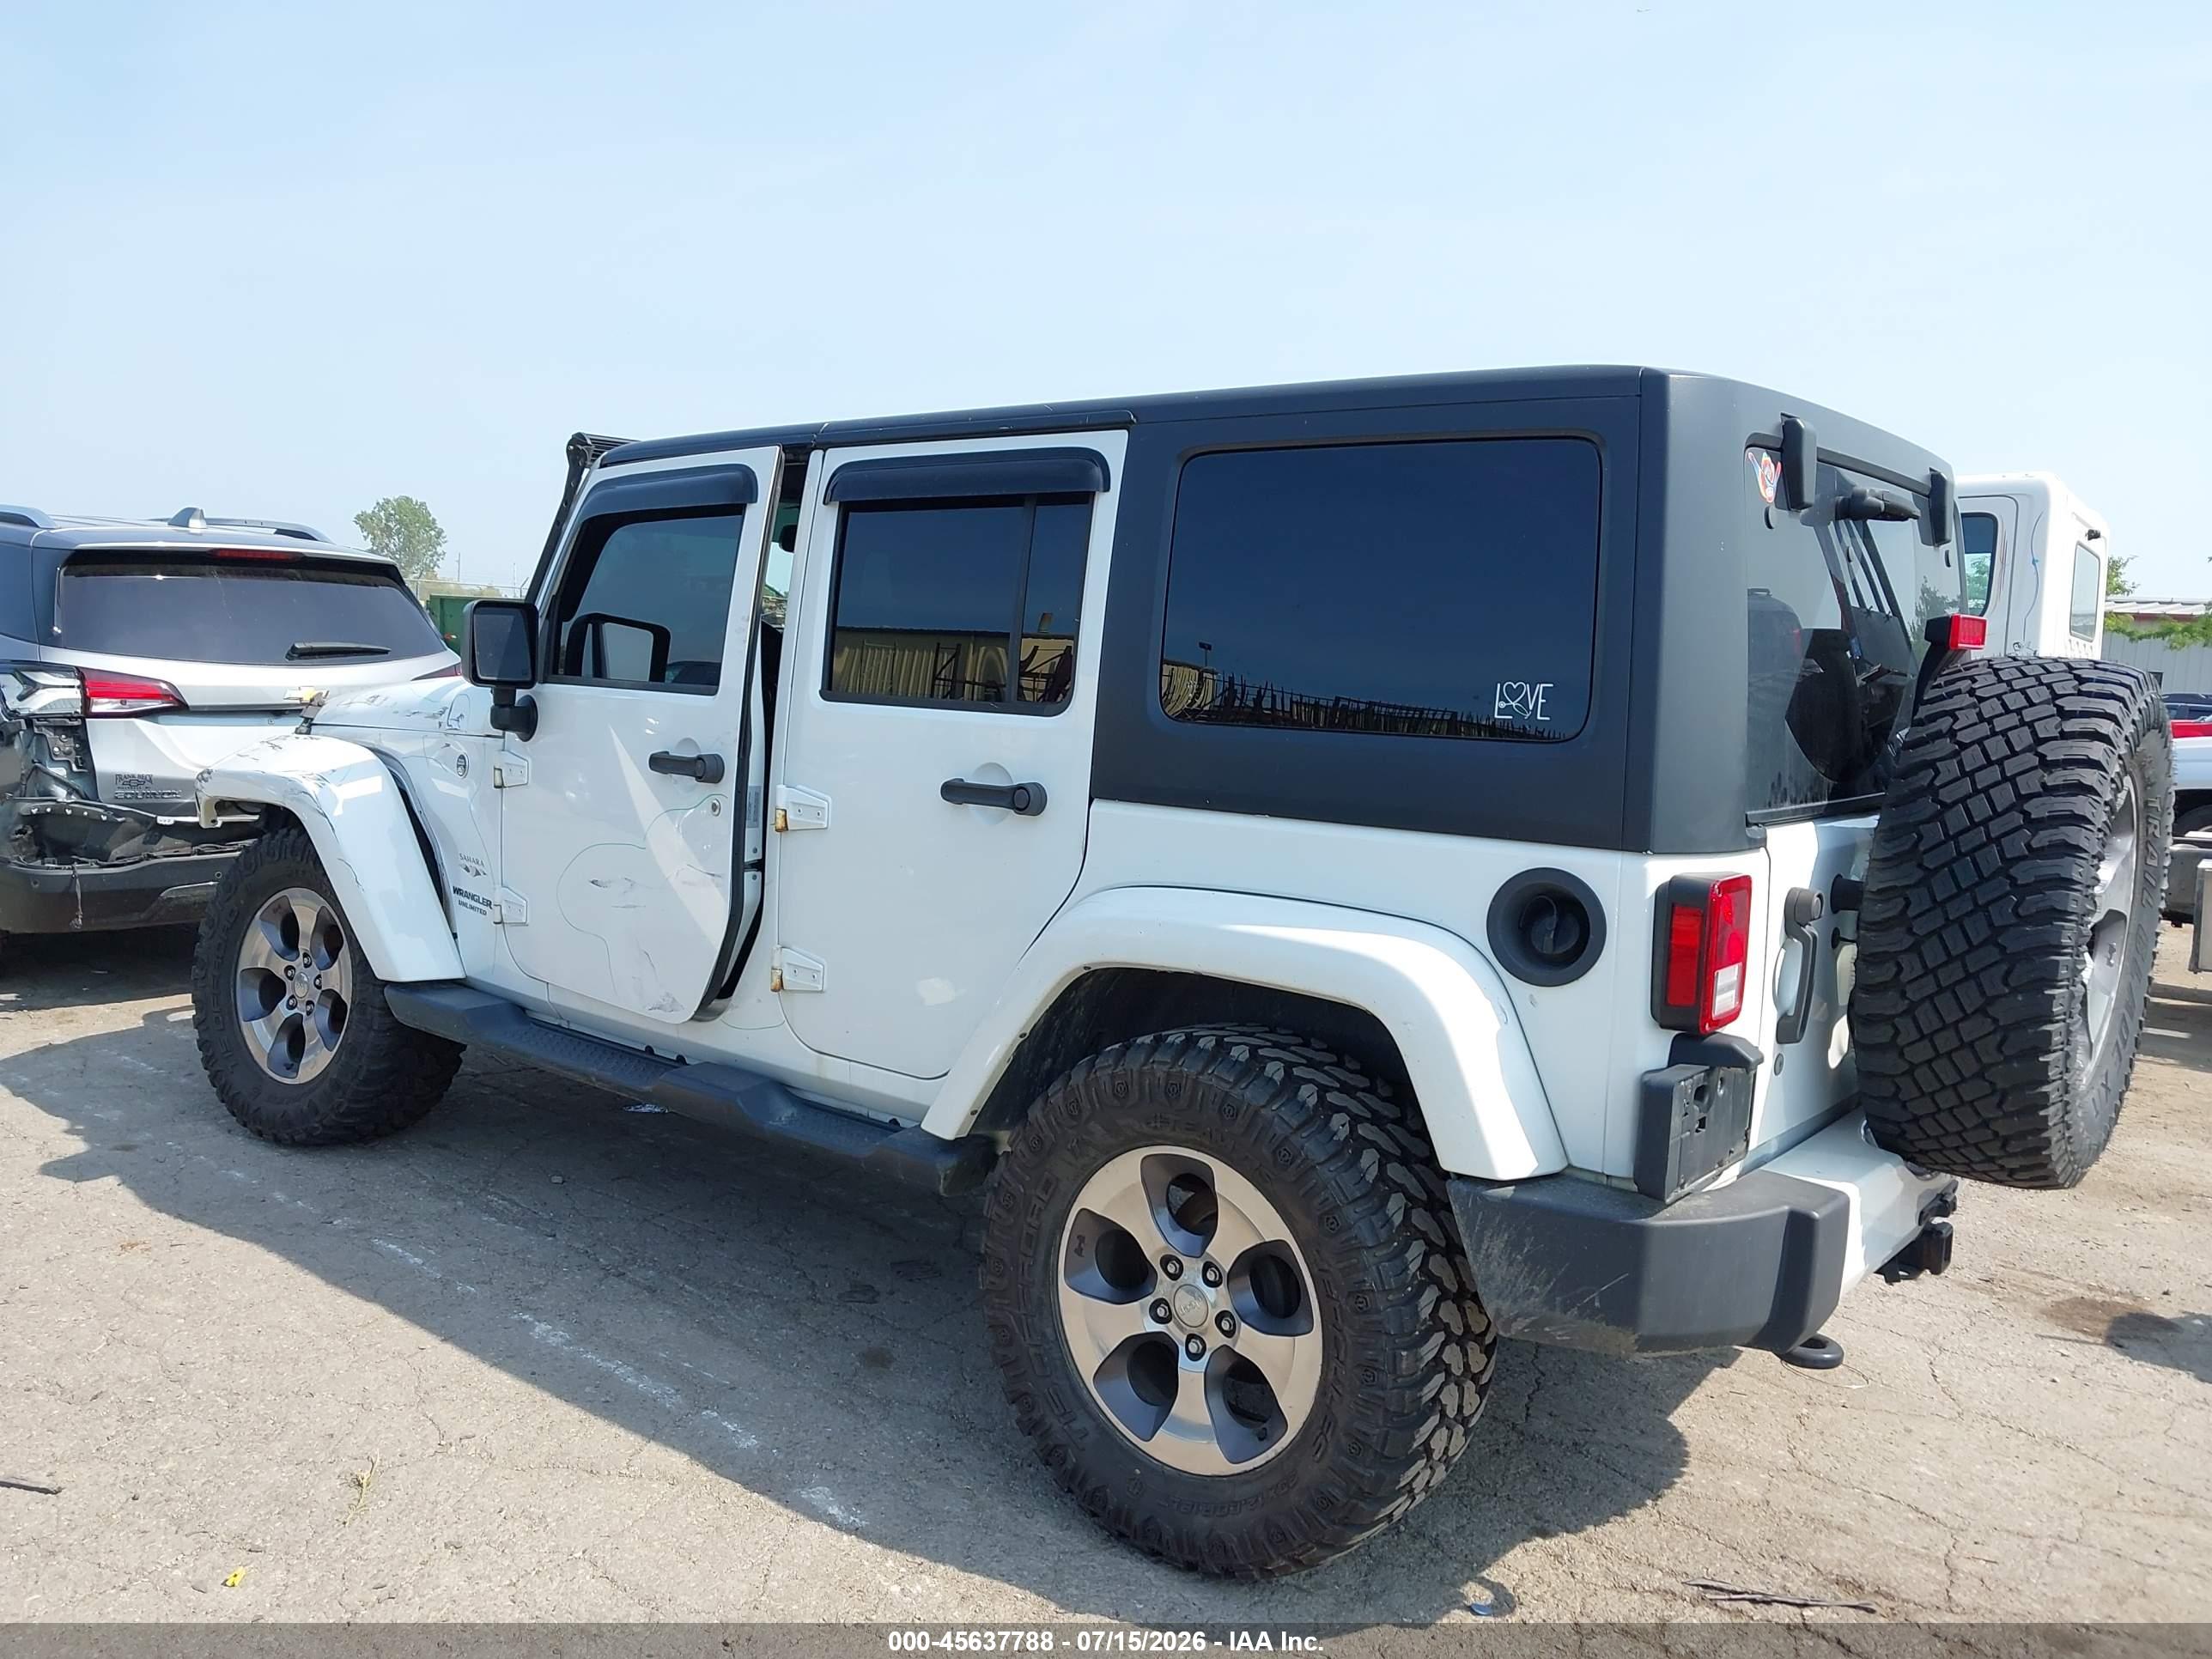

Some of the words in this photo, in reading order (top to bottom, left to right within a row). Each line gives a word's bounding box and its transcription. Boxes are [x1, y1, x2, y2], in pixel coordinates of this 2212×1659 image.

[115, 774, 137, 785] FRANK
[137, 774, 154, 785] BECK
[114, 789, 182, 799] EQUINOX
[2142, 795, 2162, 908] TRAIL
[459, 854, 484, 866] SAHARA
[453, 886, 492, 909] WRANGLER
[459, 900, 487, 915] UNLIMITED
[2112, 922, 2147, 1067] BLADE
